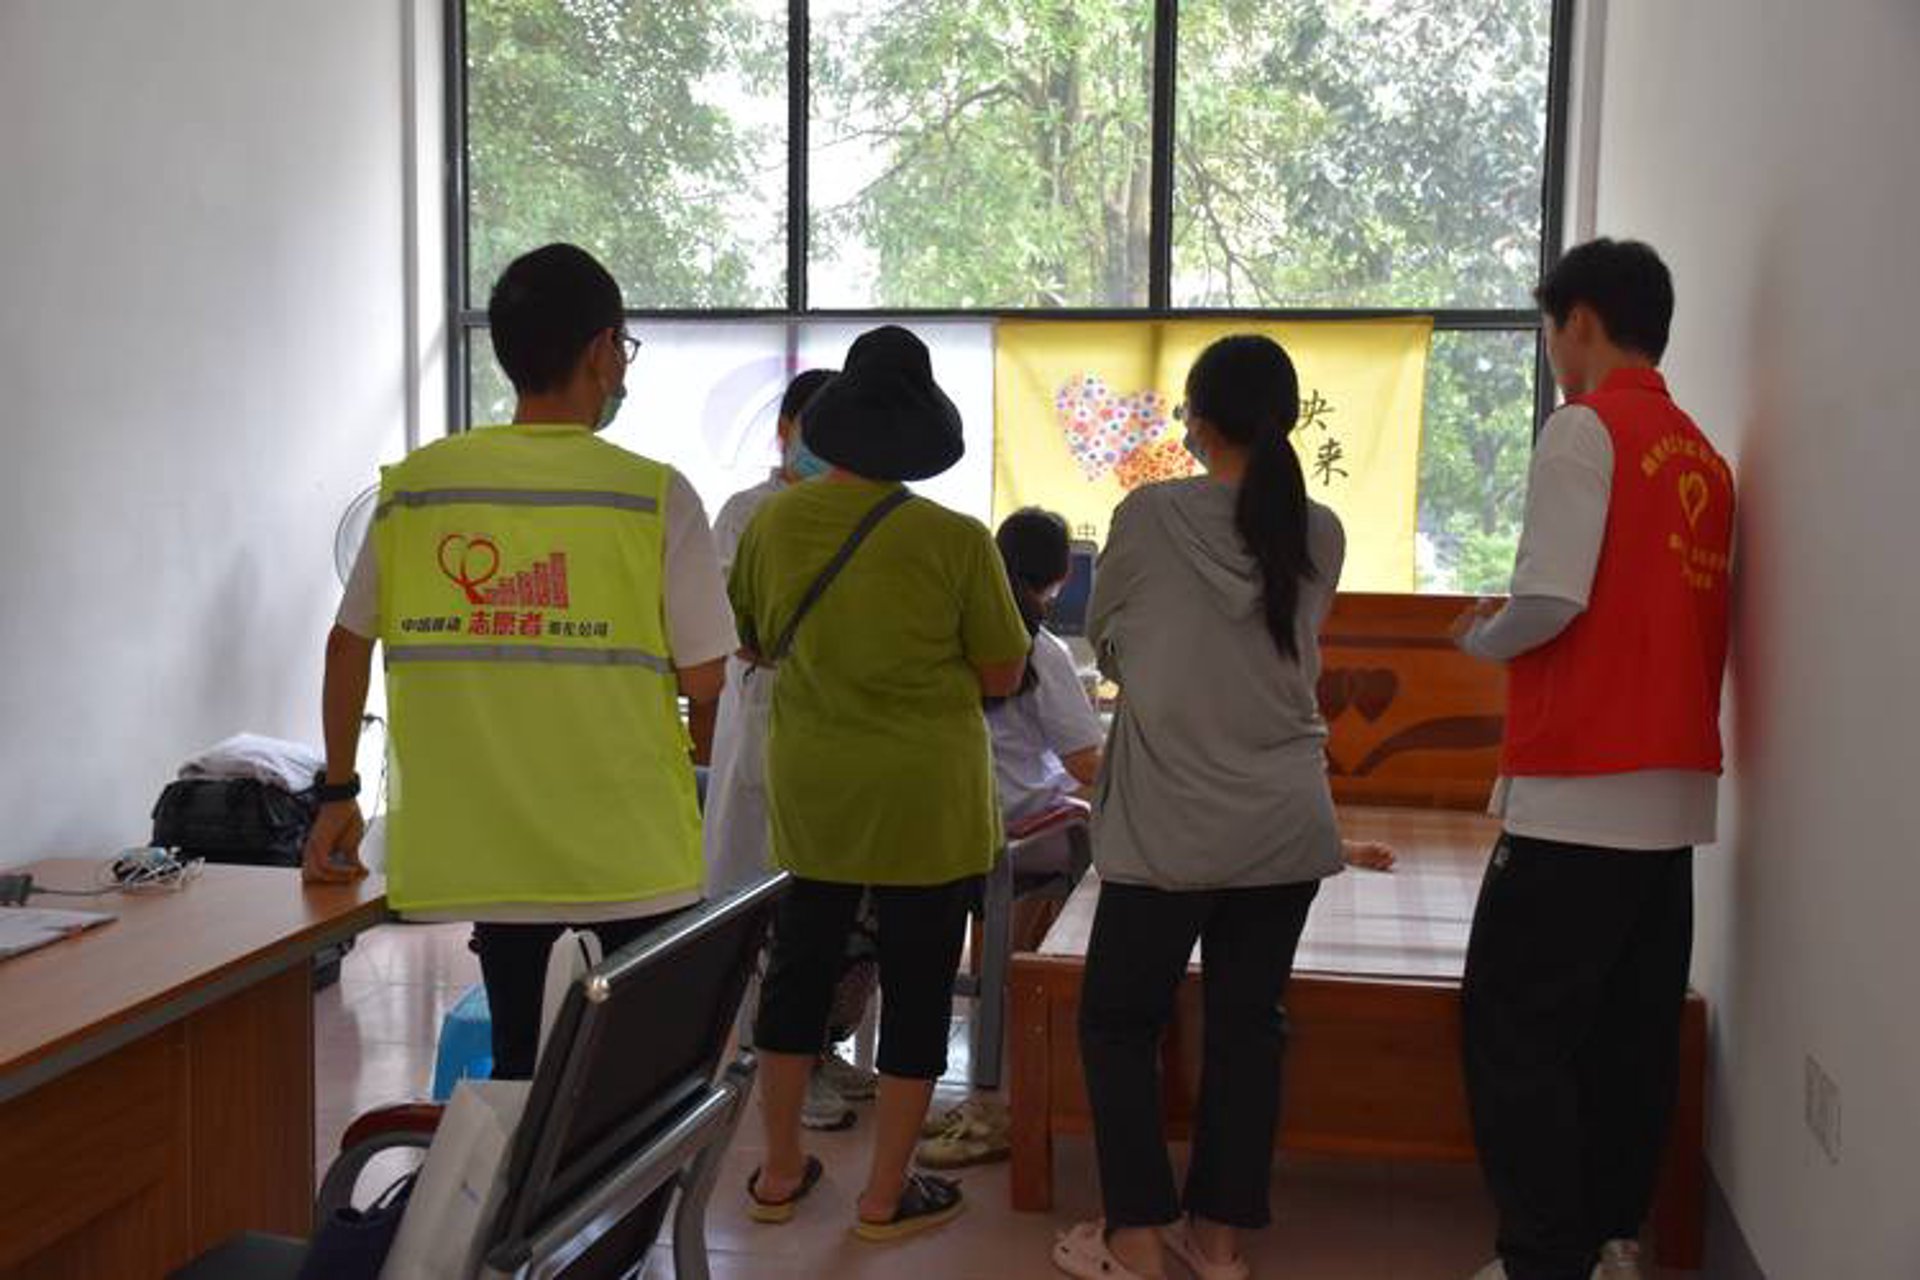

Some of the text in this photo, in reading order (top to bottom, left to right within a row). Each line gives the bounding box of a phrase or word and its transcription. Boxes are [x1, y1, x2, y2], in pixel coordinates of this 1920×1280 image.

[1311, 437, 1349, 486] 来
[1077, 518, 1096, 541] 中
[468, 610, 543, 637] 志愿者
